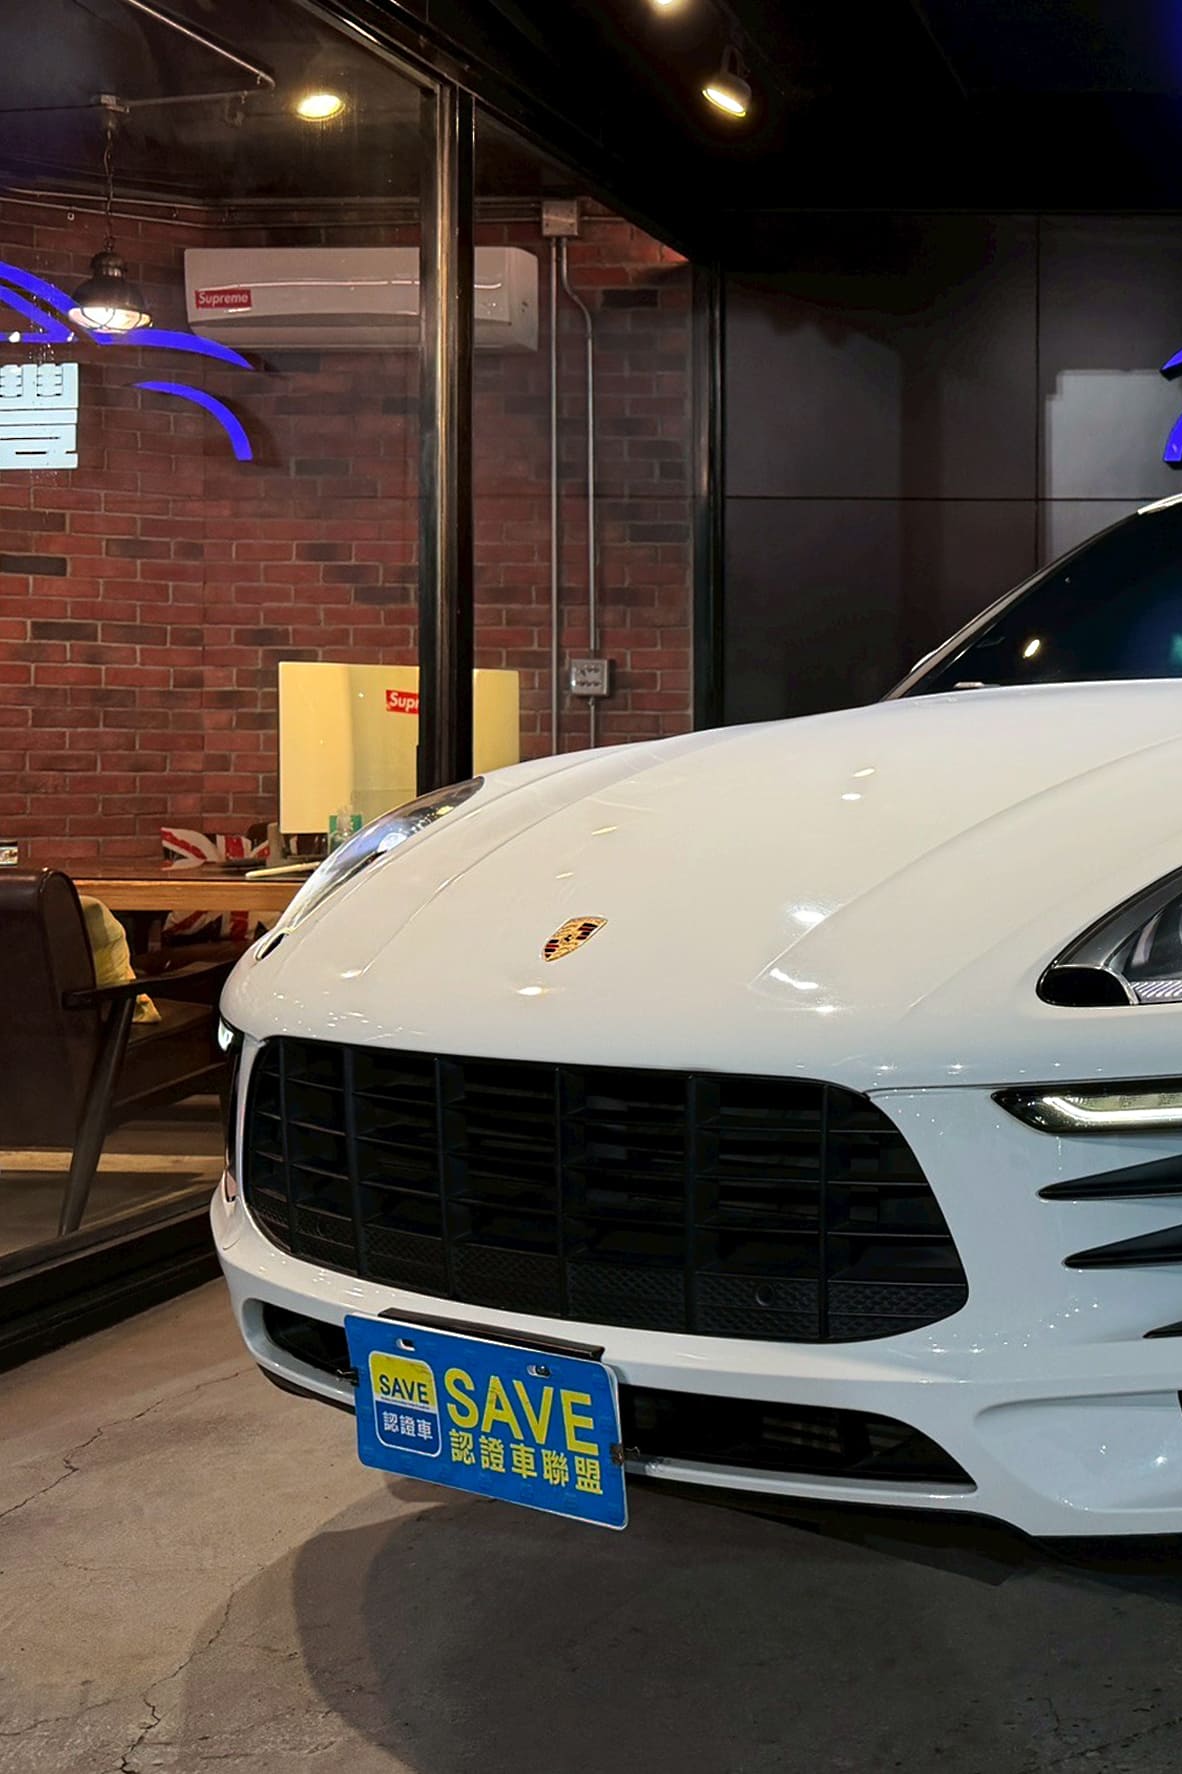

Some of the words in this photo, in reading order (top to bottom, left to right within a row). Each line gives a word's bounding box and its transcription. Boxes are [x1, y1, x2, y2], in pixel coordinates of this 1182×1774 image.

[199, 292, 249, 307] Supreme
[379, 1374, 430, 1404] SAVE
[382, 1411, 433, 1440] 認證車
[444, 1368, 599, 1455] SAVE
[448, 1429, 604, 1495] 認證車聯盟
